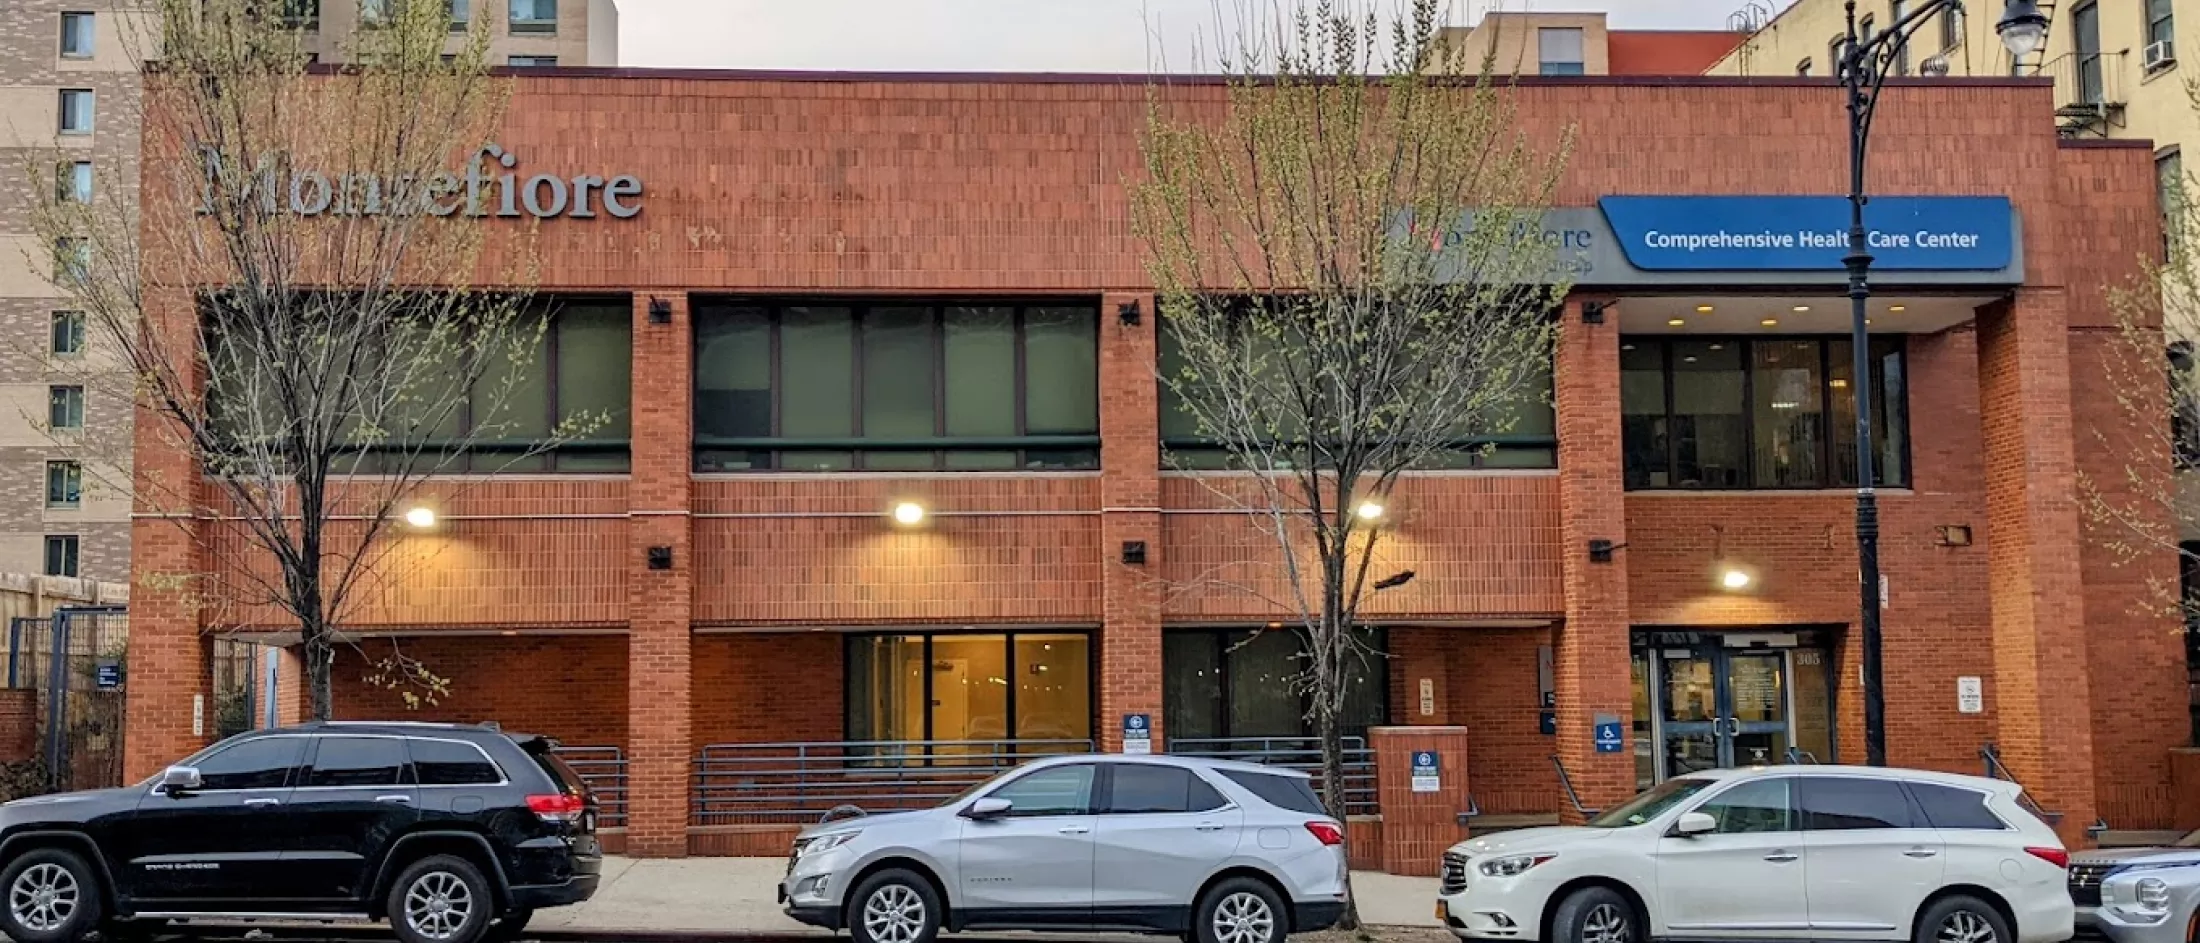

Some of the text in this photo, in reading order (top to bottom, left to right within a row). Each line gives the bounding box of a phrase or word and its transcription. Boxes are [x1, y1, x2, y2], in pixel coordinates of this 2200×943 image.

[1645, 230, 1979, 252] Comprehensive Healt Care Center
[1797, 652, 1820, 665] 305
